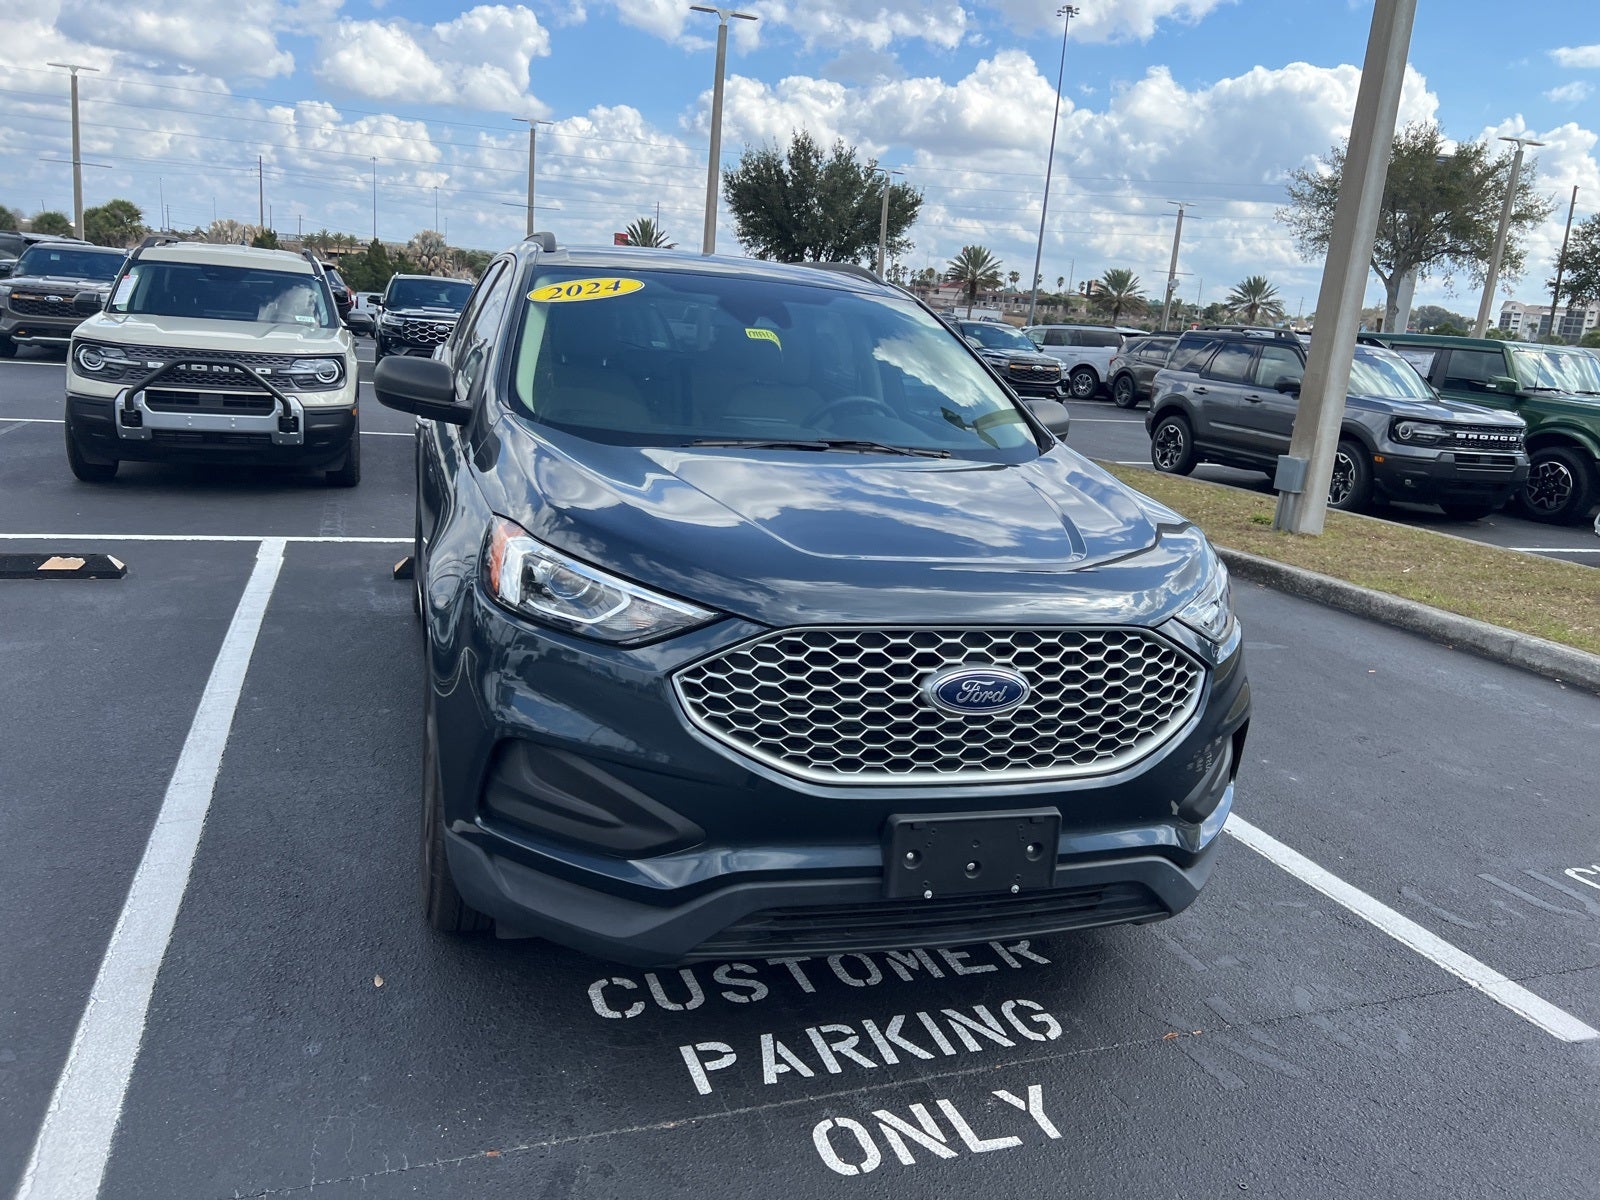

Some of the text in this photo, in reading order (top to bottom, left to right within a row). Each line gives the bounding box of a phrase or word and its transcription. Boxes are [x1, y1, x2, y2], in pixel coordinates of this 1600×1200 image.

[548, 280, 621, 300] 2024
[1456, 433, 1517, 442] BRONCO
[956, 680, 1008, 703] Ford
[587, 940, 1052, 1019] CUSTOMER
[679, 999, 1063, 1095] PARKING
[812, 1085, 1062, 1176] ONLY
